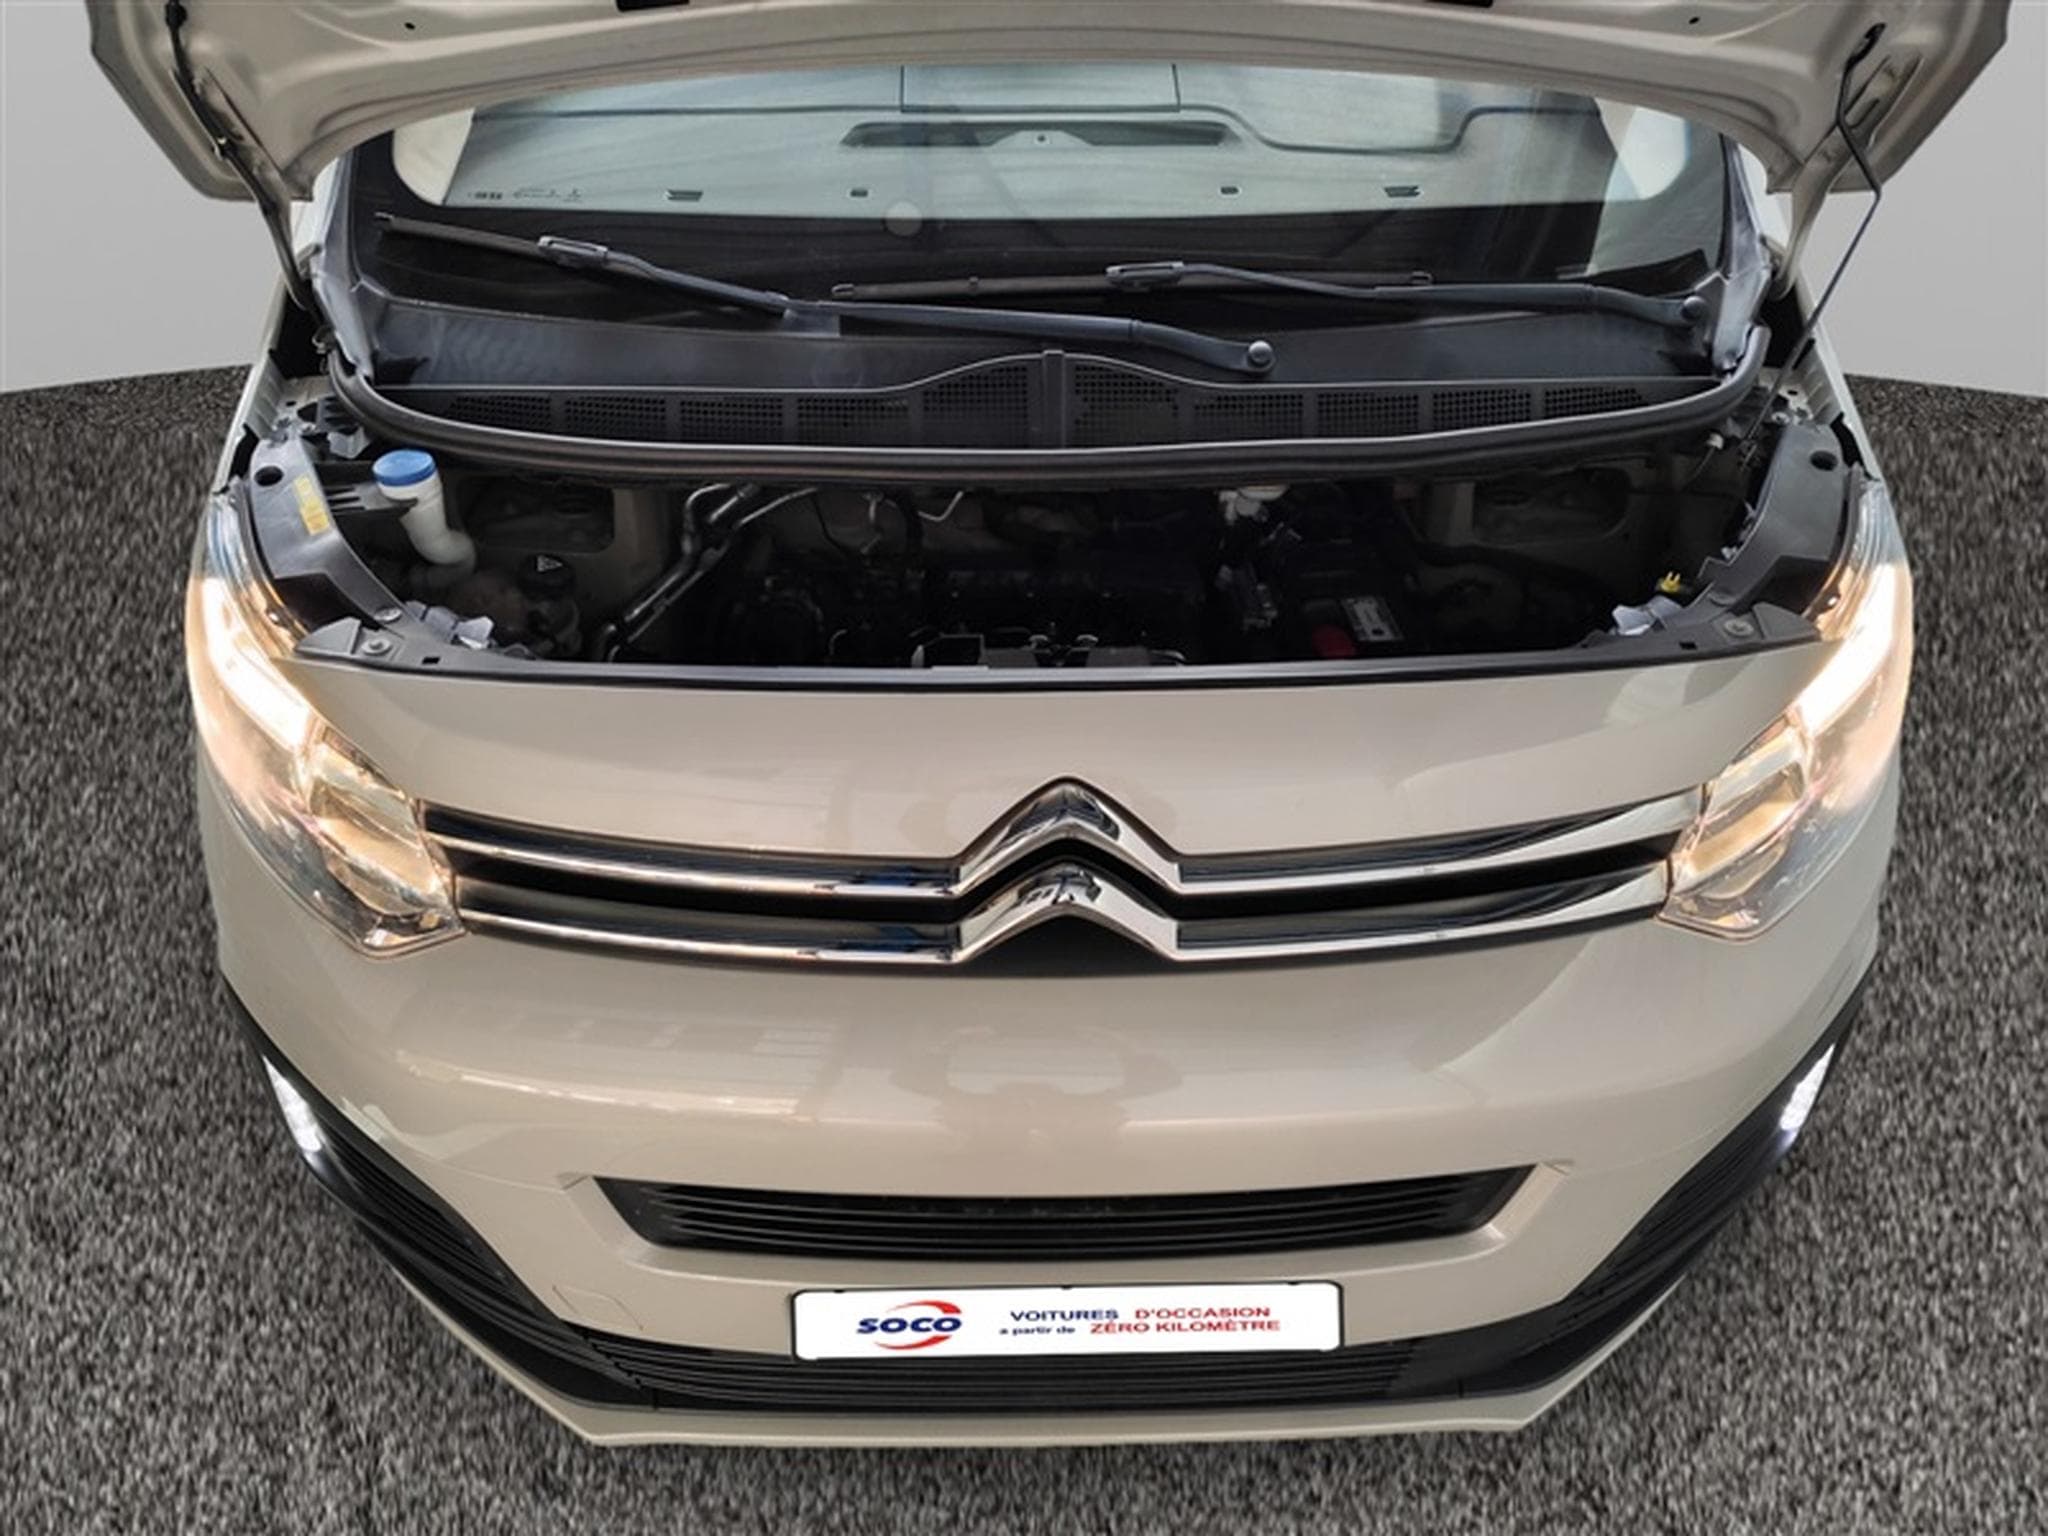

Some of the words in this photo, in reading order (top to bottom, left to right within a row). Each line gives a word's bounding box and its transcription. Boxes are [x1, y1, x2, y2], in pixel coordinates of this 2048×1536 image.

[1010, 1310, 1119, 1321] VOITURES
[1135, 1307, 1271, 1320] D'OCCASION
[857, 1317, 962, 1334] SOCO
[1012, 1326, 1051, 1336] partir
[1056, 1325, 1075, 1334] de
[1090, 1319, 1150, 1334] ZÉRO
